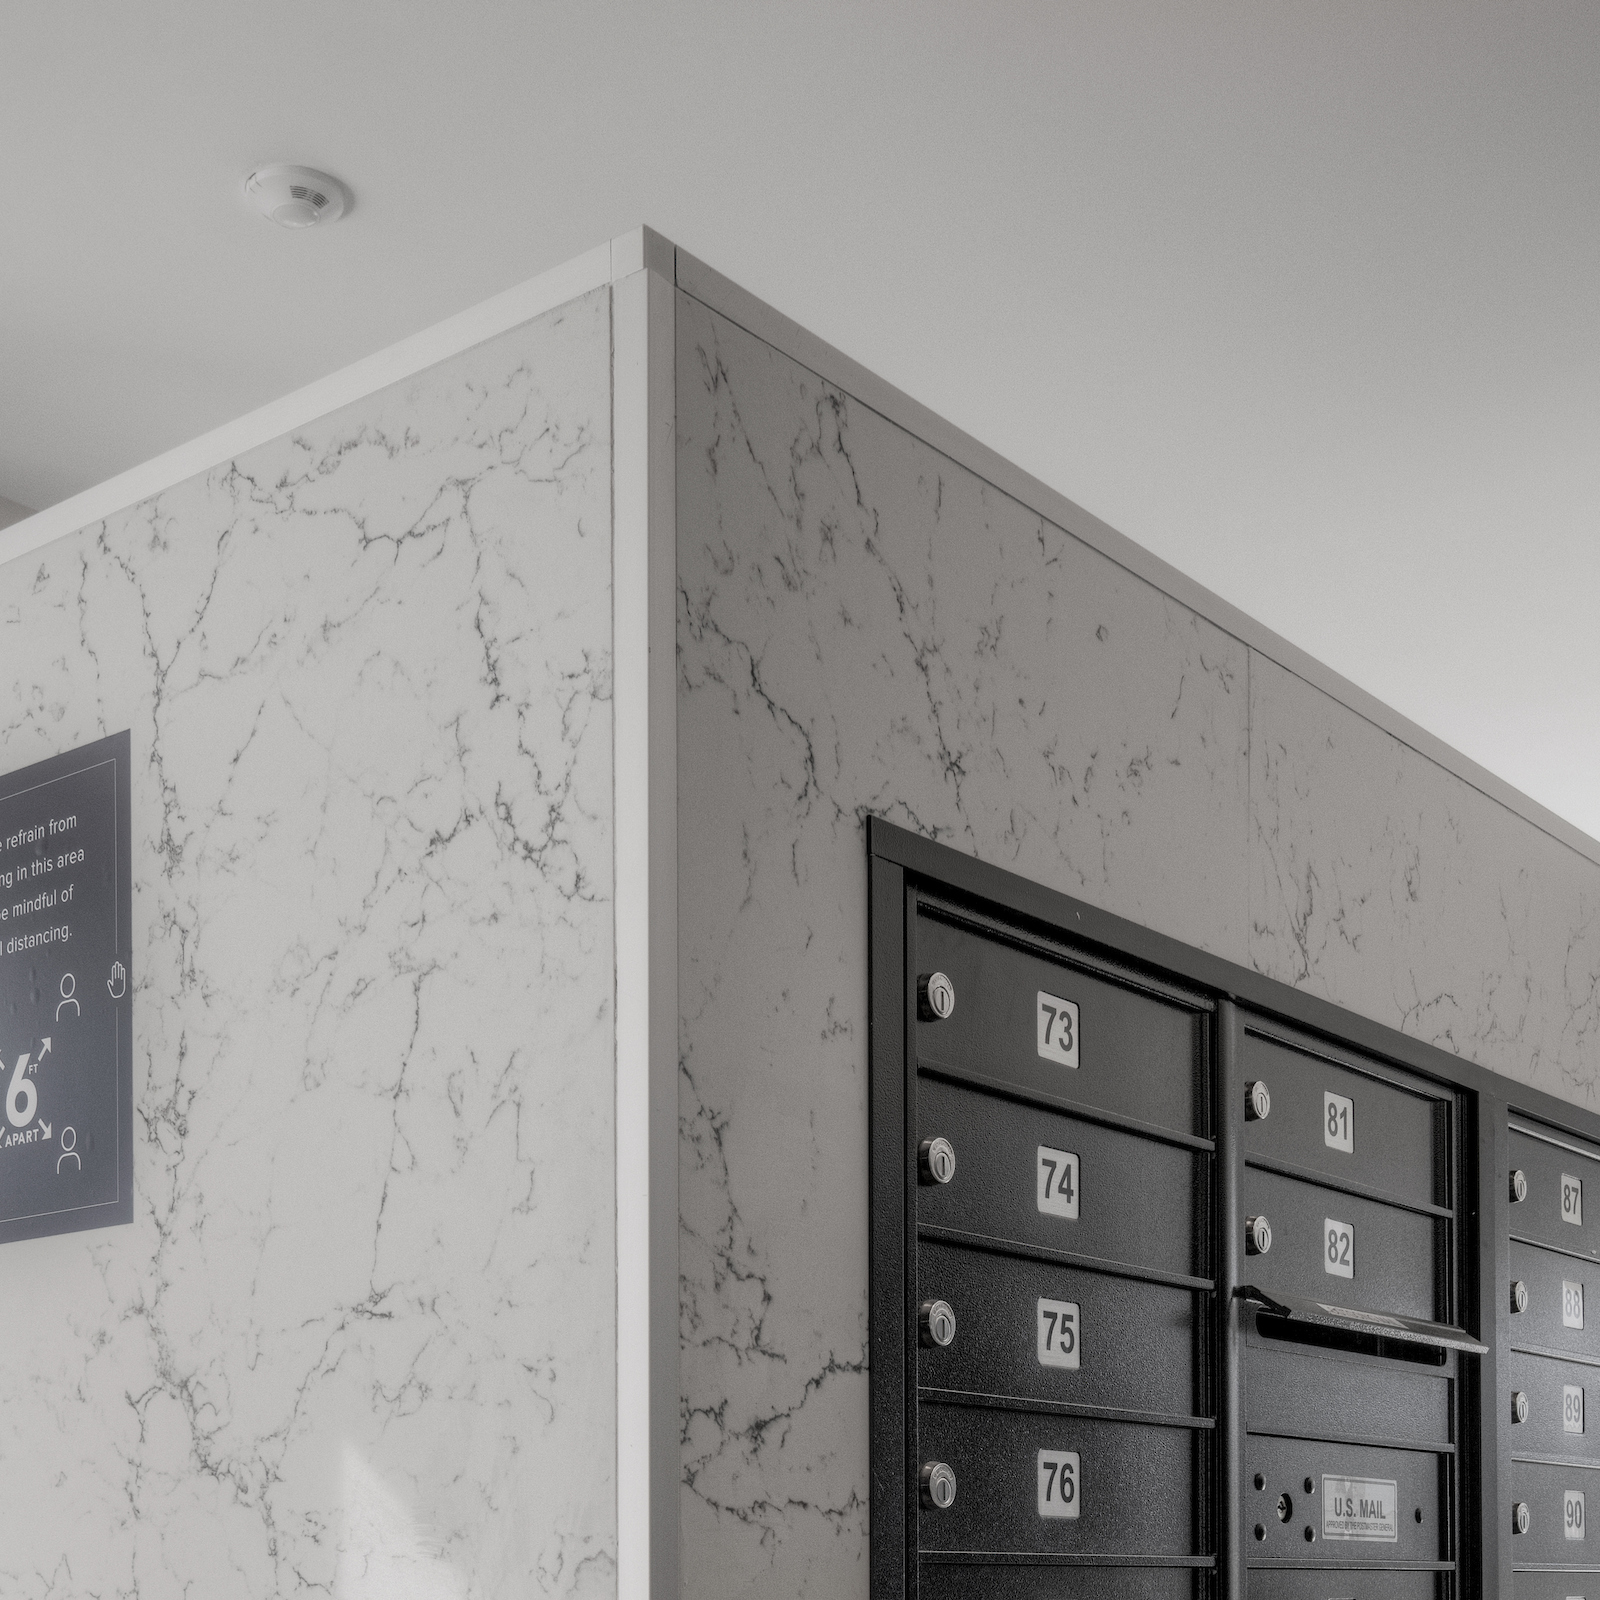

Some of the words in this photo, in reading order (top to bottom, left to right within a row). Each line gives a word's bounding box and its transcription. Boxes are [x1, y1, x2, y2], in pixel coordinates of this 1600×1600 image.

[6, 825, 45, 850] refrain
[49, 814, 77, 836] from
[16, 866, 28, 882] in
[31, 857, 53, 876] this
[57, 848, 85, 868] area
[12, 890, 57, 918] mindful
[61, 884, 75, 901] of
[6, 923, 73, 954] distancing.
[1041, 1004, 1074, 1053] 73
[5, 1052, 38, 1128] 6
[28, 1063, 39, 1075] FT
[5, 1128, 40, 1148] APART
[1327, 1101, 1349, 1141] 81
[1041, 1158, 1074, 1204] 74
[1563, 1183, 1580, 1216] 87
[1327, 1228, 1351, 1268] 82
[1564, 1289, 1581, 1320] 88
[1042, 1310, 1075, 1355] 75
[1564, 1393, 1581, 1422] 89
[1042, 1461, 1075, 1504] 76
[1334, 1497, 1357, 1518] U.S.
[1359, 1499, 1386, 1519] MAIL
[1565, 1499, 1583, 1530] 90
